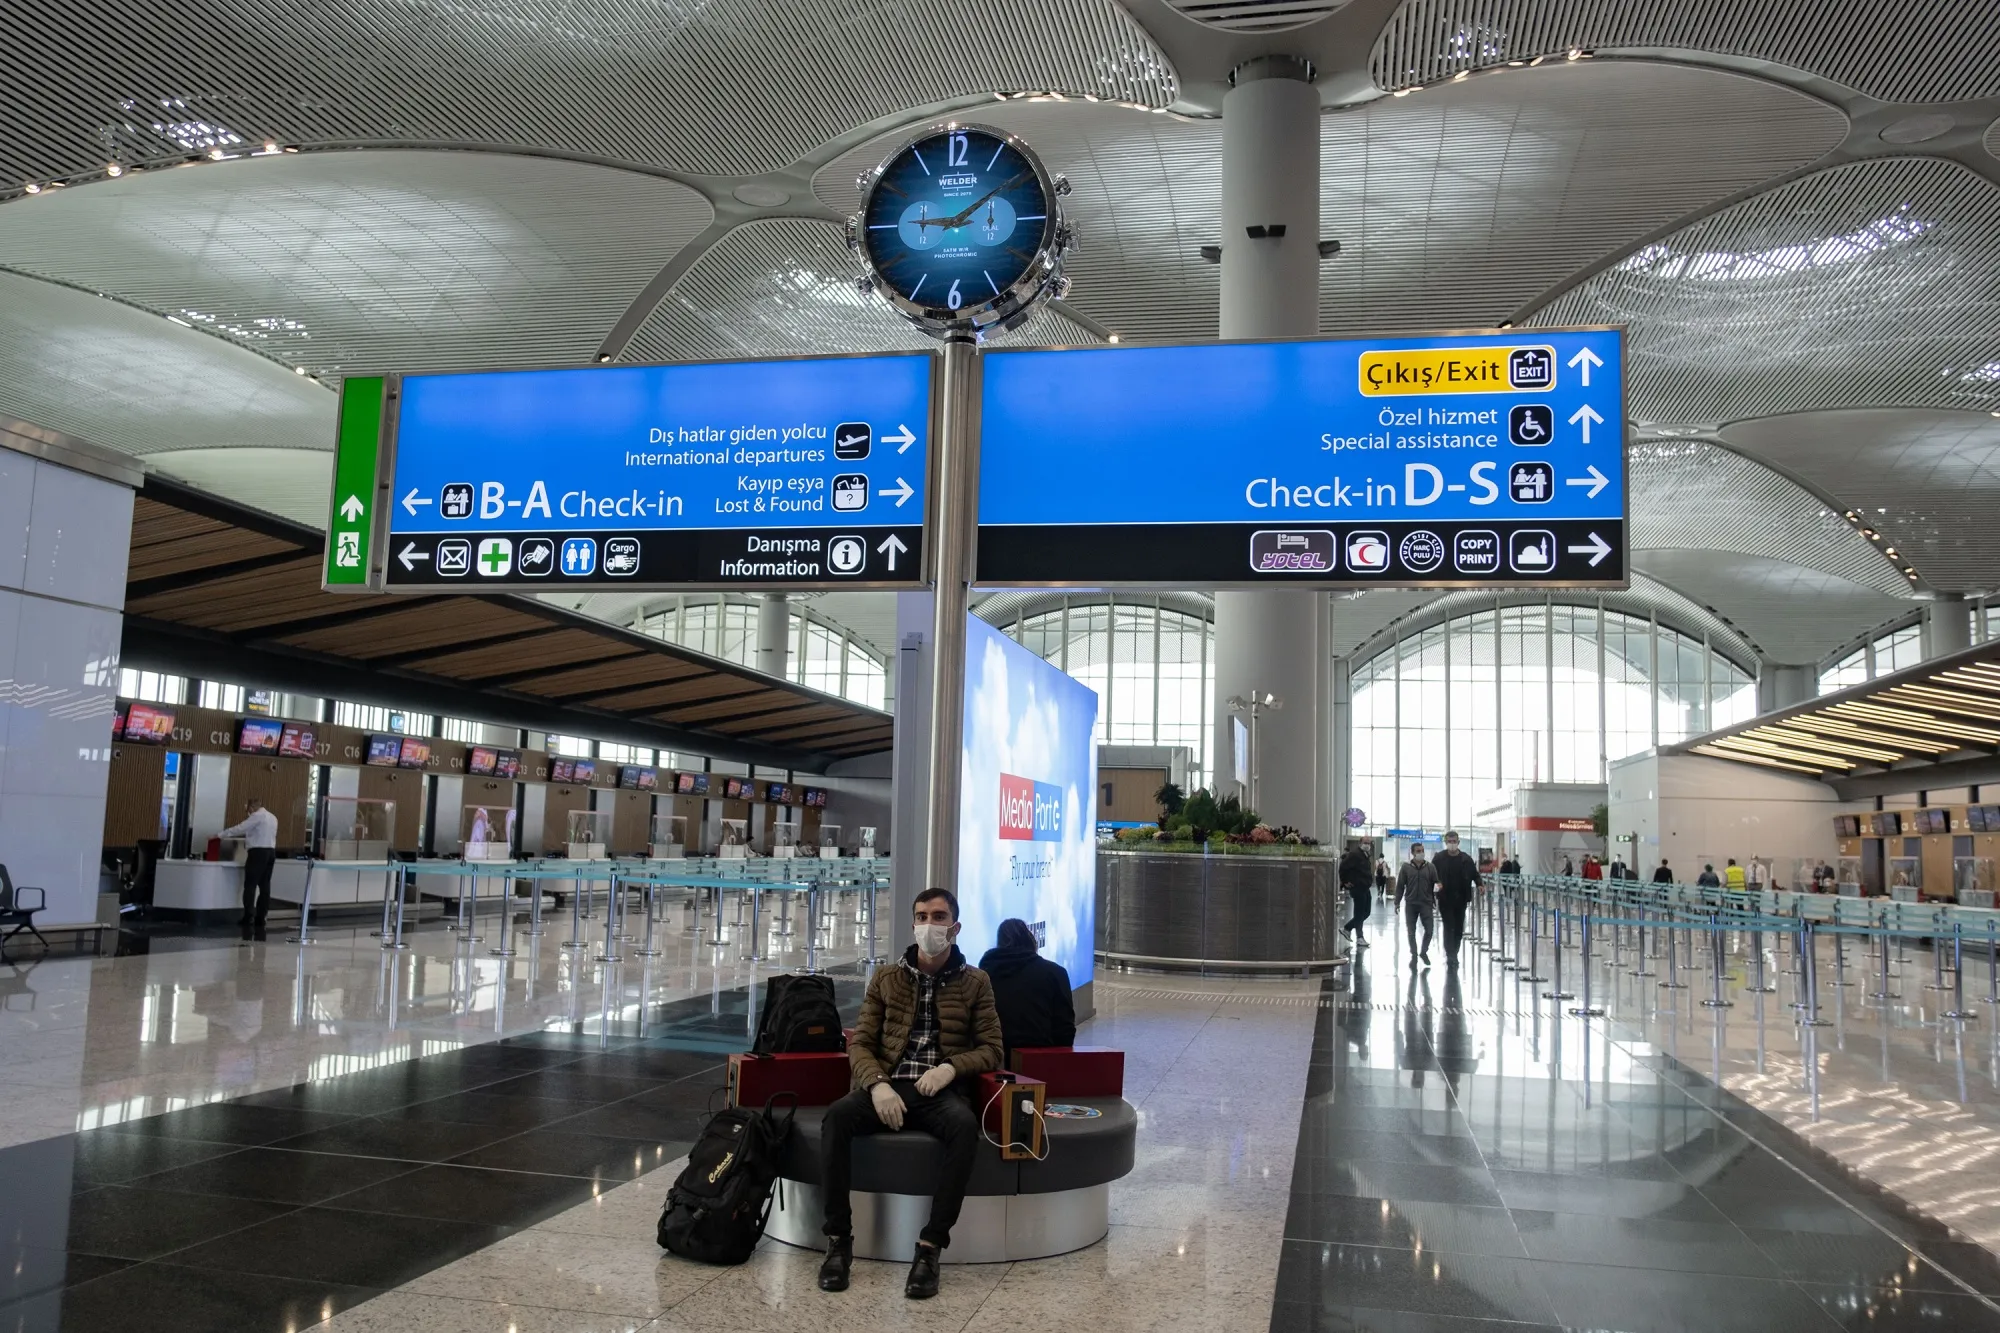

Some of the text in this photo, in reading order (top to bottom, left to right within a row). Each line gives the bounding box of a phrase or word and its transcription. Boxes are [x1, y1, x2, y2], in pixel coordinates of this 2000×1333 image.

[949, 135, 968, 166] 12
[939, 177, 977, 186] WELDER
[920, 236, 926, 244] 12
[948, 279, 961, 309] 6
[1367, 360, 1500, 390] Çıkış/Exit
[1518, 366, 1542, 377] EXIT
[1378, 406, 1498, 426] Özel hizmet
[650, 423, 826, 446] Dış hatlar giden yolcu
[1321, 432, 1498, 454] Special assistance
[625, 448, 825, 467] International departures
[738, 476, 824, 494] Kayıp eşya
[1245, 461, 1499, 508] Check-in D-S
[480, 481, 683, 519] B-A Check-in
[715, 495, 823, 513] Lost & Found
[610, 543, 635, 554] Cargo
[747, 536, 820, 555] Danışma
[1460, 539, 1492, 549] COPY
[720, 559, 819, 576] Information
[1460, 554, 1494, 564] PRINT
[172, 727, 192, 741] C19
[210, 731, 230, 745] C18
[344, 746, 360, 758] C16
[450, 757, 463, 768] C14
[536, 766, 547, 776] C12
[1101, 783, 1112, 806] 1
[1001, 787, 1032, 830] Media
